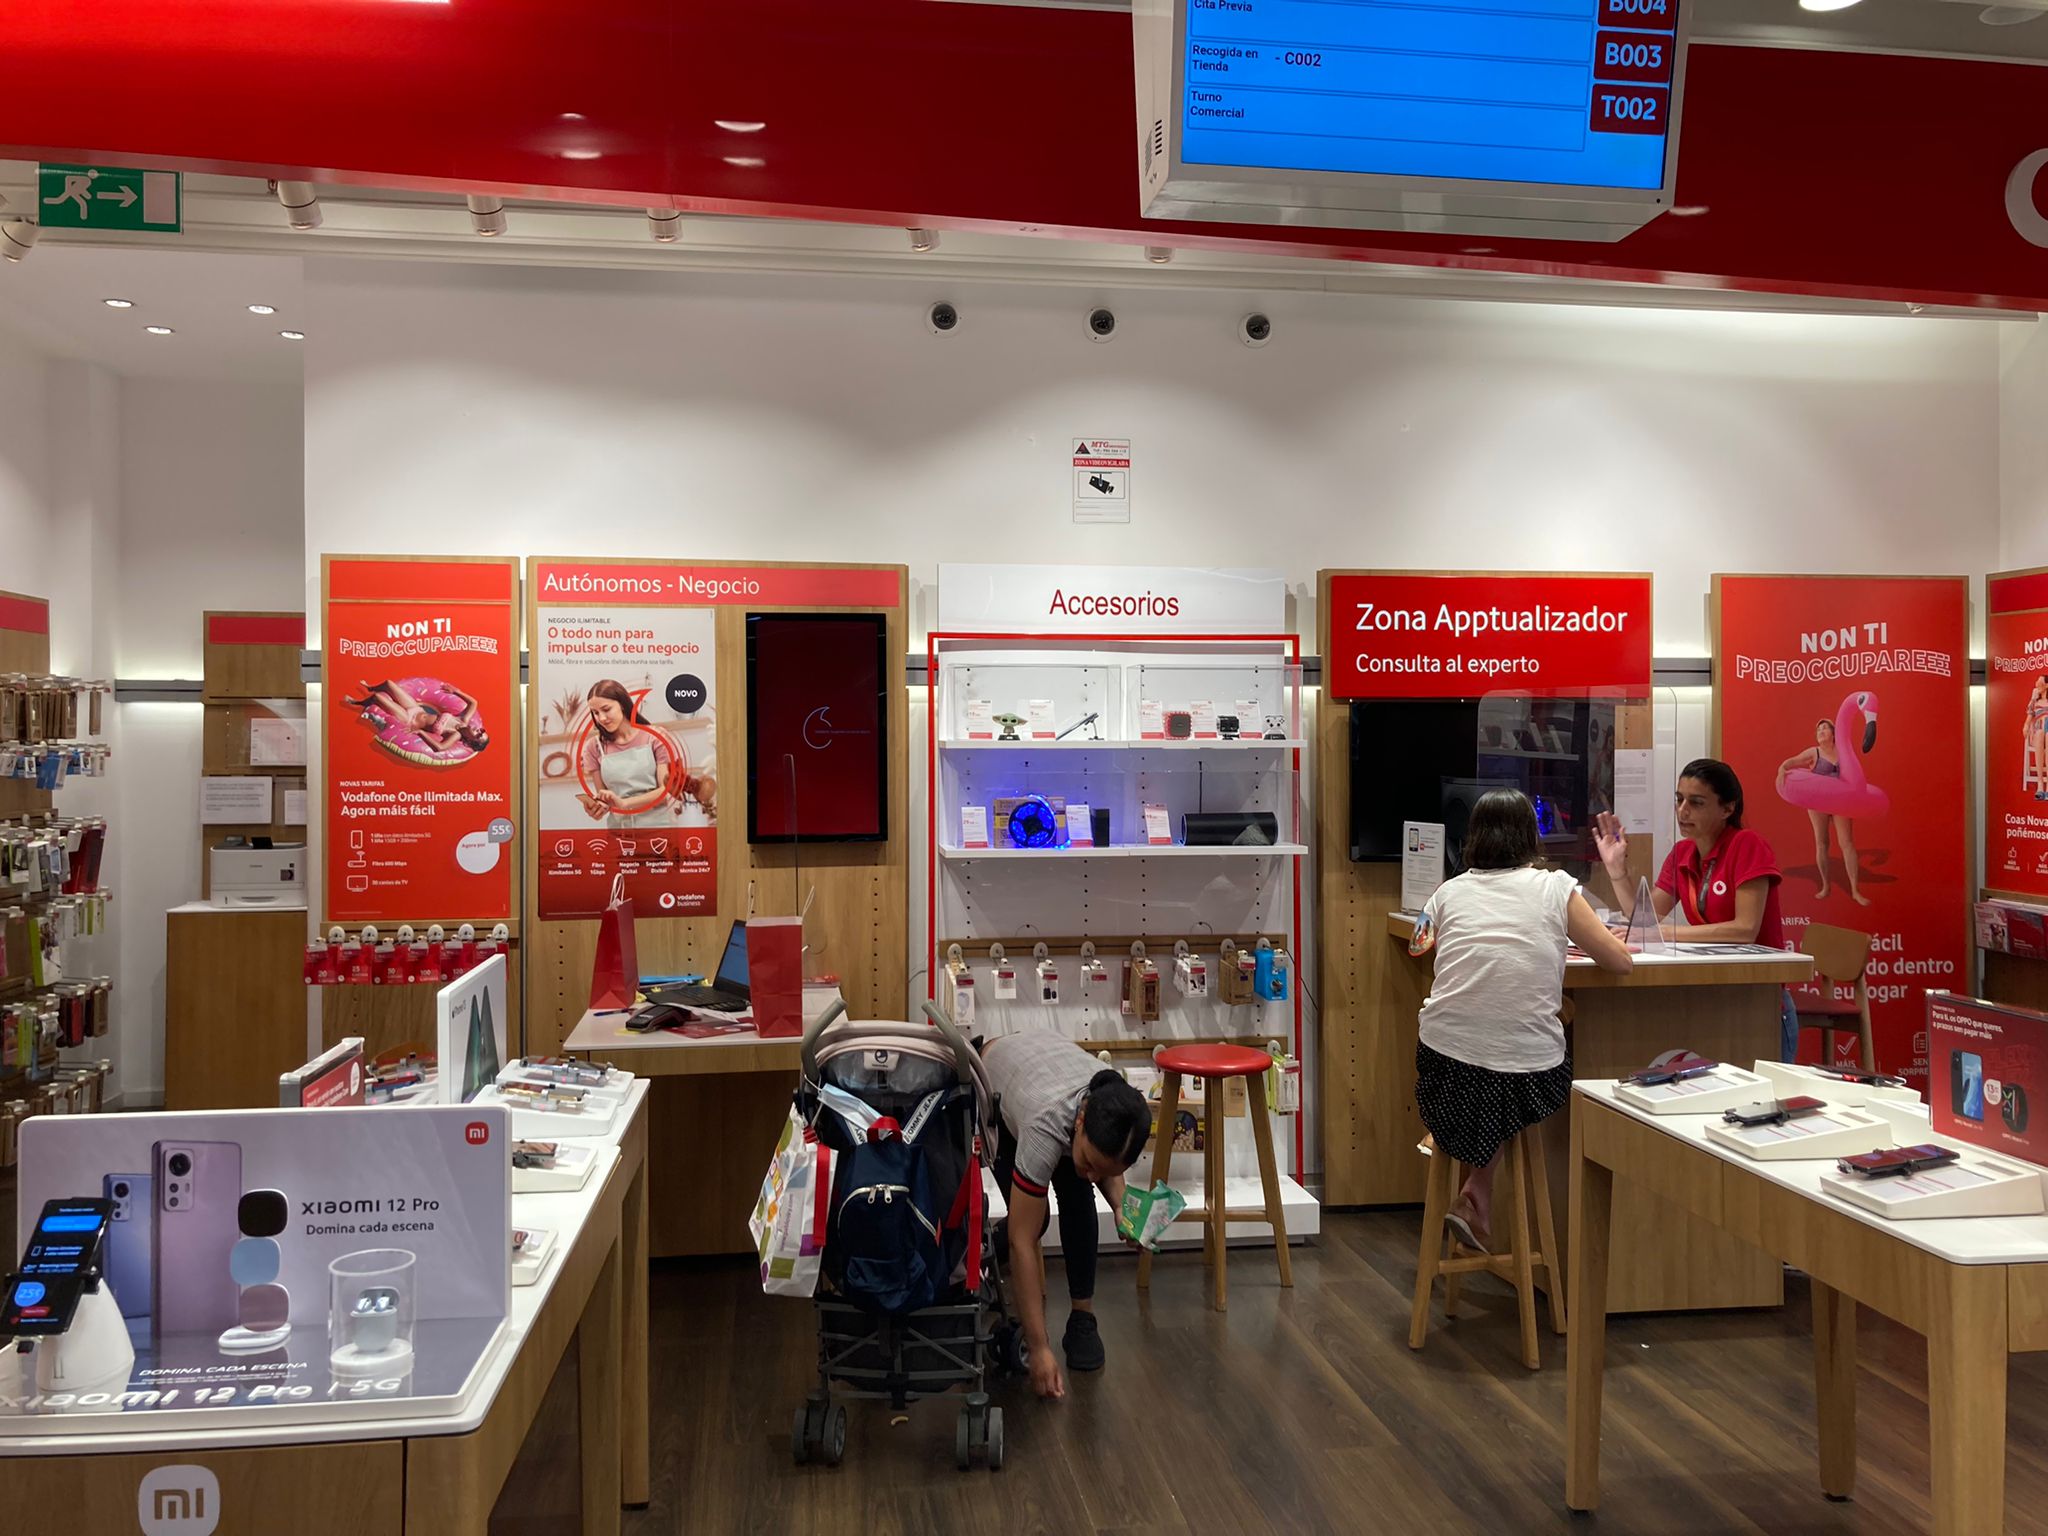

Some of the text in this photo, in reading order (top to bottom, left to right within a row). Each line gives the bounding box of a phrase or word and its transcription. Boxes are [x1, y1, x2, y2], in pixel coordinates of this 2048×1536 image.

[1218, 0, 1253, 12] Previa
[1192, 45, 1259, 59] Recogida en
[1604, 42, 1662, 68] B003
[1192, 60, 1229, 72] Tienda
[1284, 52, 1322, 67] C002
[1191, 91, 1222, 102] Turno
[1190, 106, 1245, 118] Comercial
[1601, 95, 1657, 120] T002
[544, 572, 662, 593] Autónomos
[678, 576, 760, 598] Negocio
[1049, 589, 1180, 616] Accesorios
[1356, 603, 1629, 637] Zona Apptualizador
[387, 617, 452, 638] NON TI
[547, 626, 654, 641] O todo nun para
[1800, 622, 1888, 654] NON TI
[548, 642, 700, 656] impulsar o teu negocio
[1355, 654, 1540, 676] Consulta al experto
[1994, 653, 2048, 673] PREOCCU
[674, 690, 698, 698] NOVO
[341, 791, 503, 803] Vodafone One Ilimitada Max.
[341, 804, 436, 818] Agora máis fácil
[2005, 813, 2048, 827] Coas Nova
[2006, 827, 2048, 840] poñémos
[559, 844, 570, 852] 5G
[1781, 917, 1811, 926] ARIFAS
[1870, 933, 1904, 951] ácil
[1893, 958, 1955, 974] dentro
[1832, 985, 1855, 999] eu
[1867, 985, 1909, 1003] ogar
[1932, 1010, 1944, 1020] Para
[1956, 1015, 1972, 1026] OPPO
[1972, 1020, 1983, 1029] que
[1964, 1028, 1979, 1038] pagar
[1836, 1059, 1857, 1069] MÁIS
[1913, 1058, 1929, 1066] SEN
[1897, 1067, 1929, 1076] SORPRE
[905, 1113, 924, 1137] OMMY
[469, 1127, 486, 1139] mi
[387, 1199, 406, 1212] 12
[412, 1198, 440, 1211] Pro
[306, 1221, 435, 1235] Domina cada escena
[139, 1361, 308, 1376] DOMINA CADA ESCENA
[194, 1386, 237, 1404] 12
[248, 1384, 313, 1401] Pro
[350, 1377, 402, 1393] 5G
[153, 1487, 205, 1520] mi
